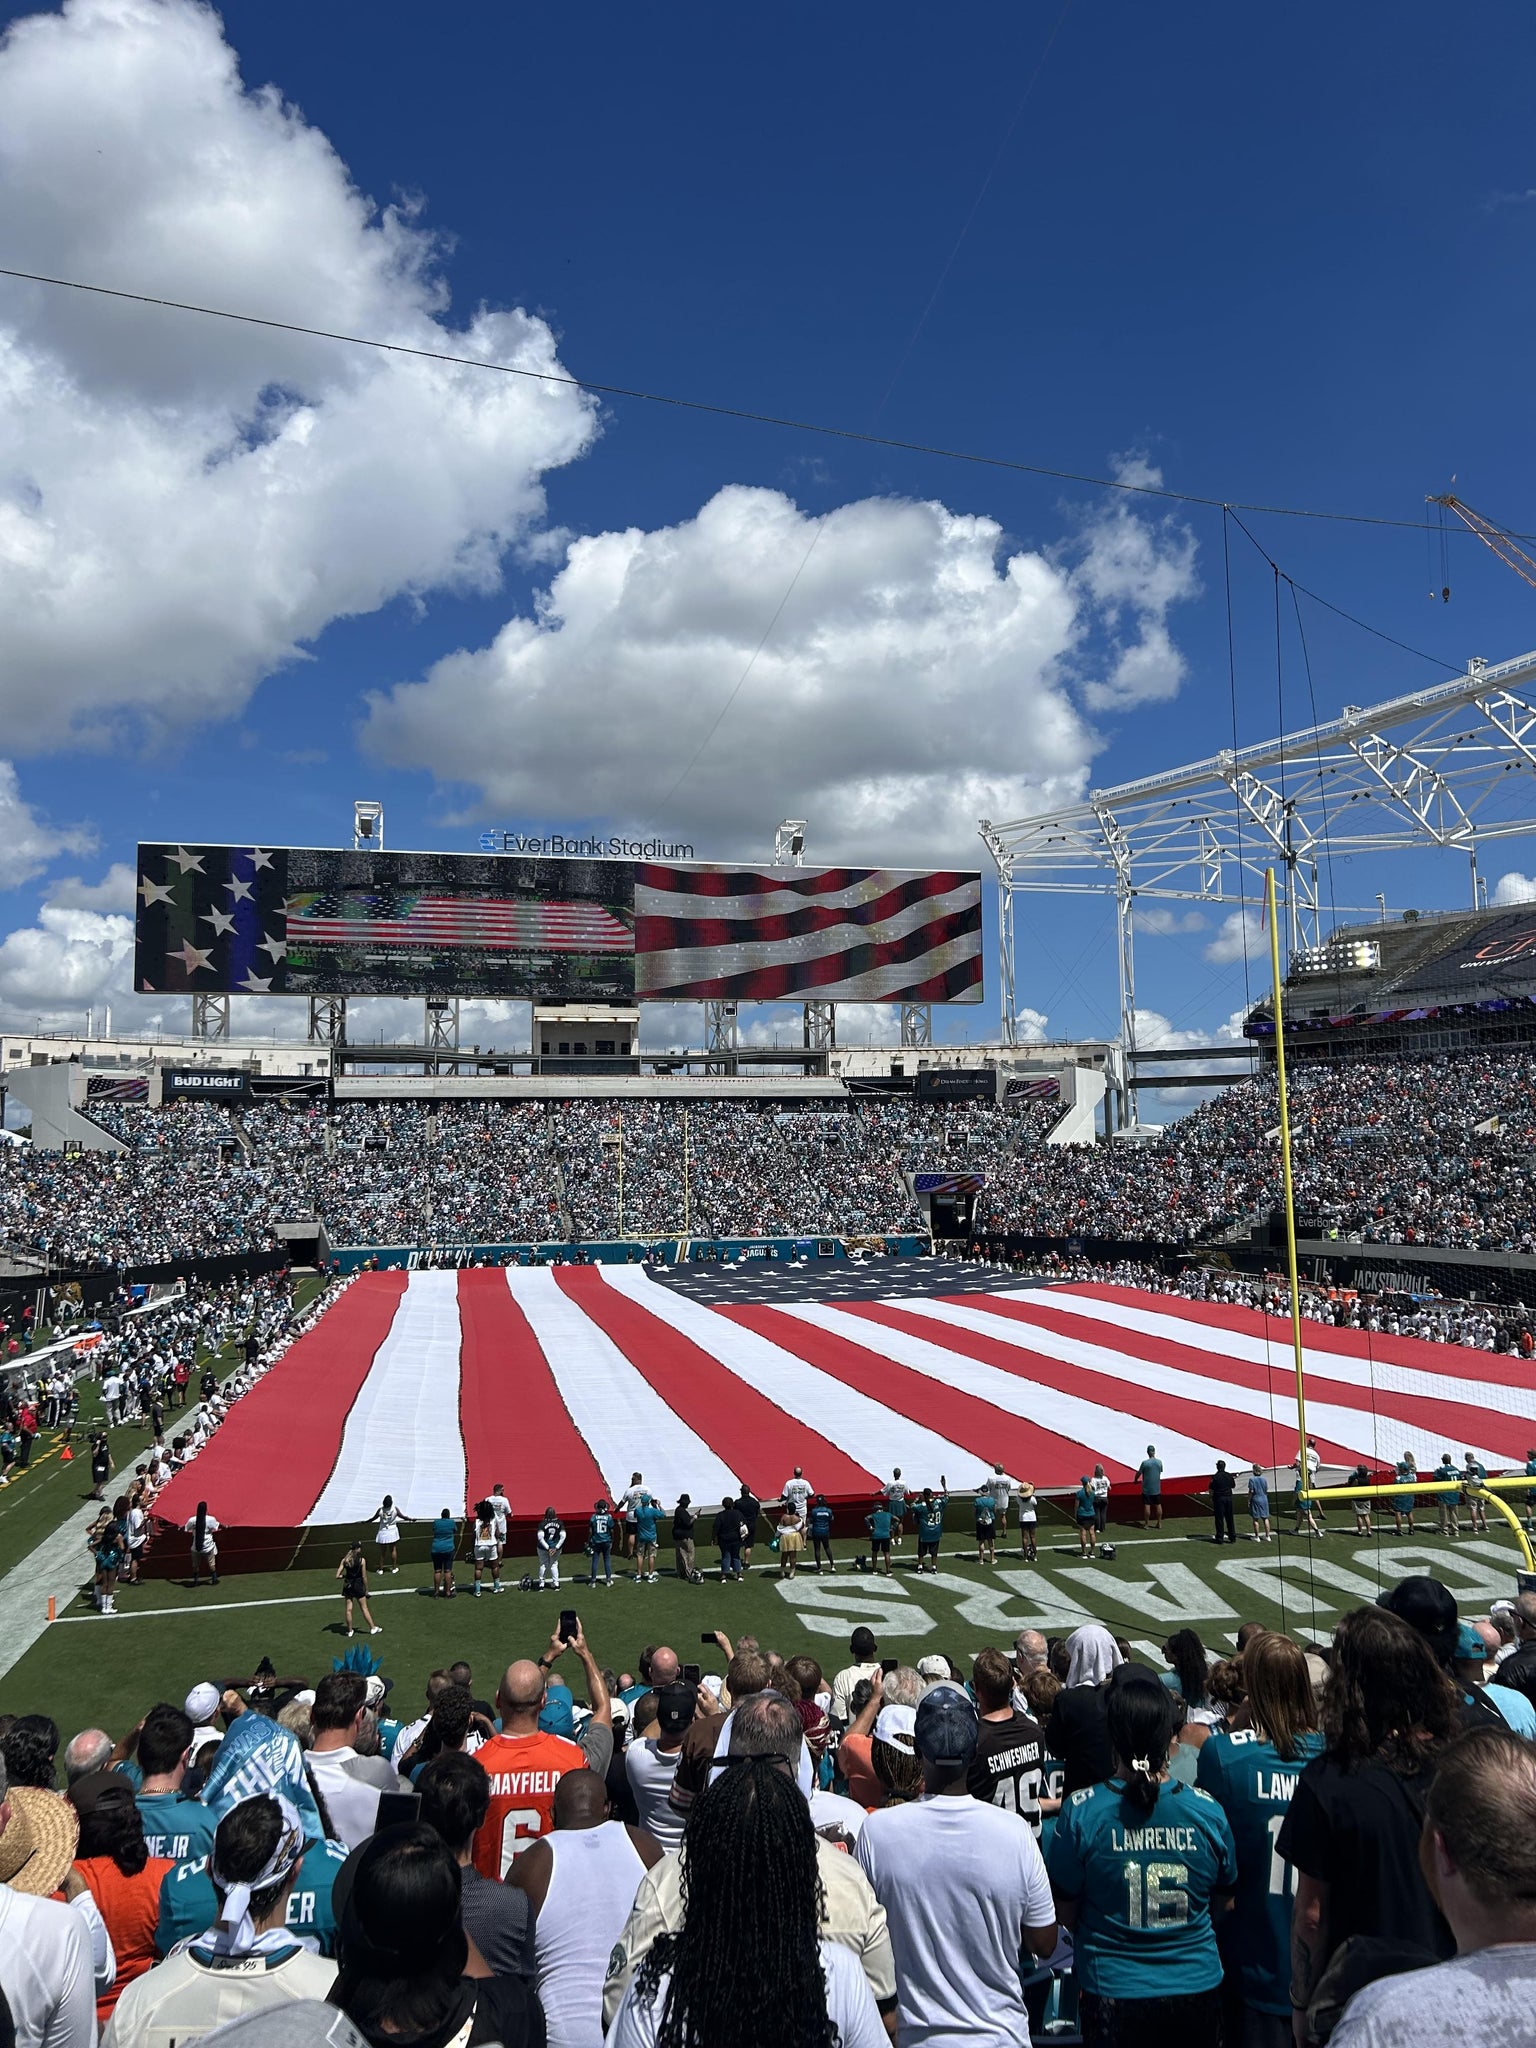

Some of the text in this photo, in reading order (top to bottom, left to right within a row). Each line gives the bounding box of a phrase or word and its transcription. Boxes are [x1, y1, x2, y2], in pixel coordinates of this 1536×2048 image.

[503, 833, 694, 858] EverBank Stadium
[174, 1076, 241, 1087] BUD LIGHT
[987, 1741, 1040, 1774] SCHWESINGER
[489, 1771, 561, 1796] MAYFIELD
[1257, 1771, 1299, 1801] LAW
[1111, 1827, 1198, 1852] LAWRENCE
[1268, 1815, 1299, 1897] 1
[1124, 1861, 1189, 1929] 16
